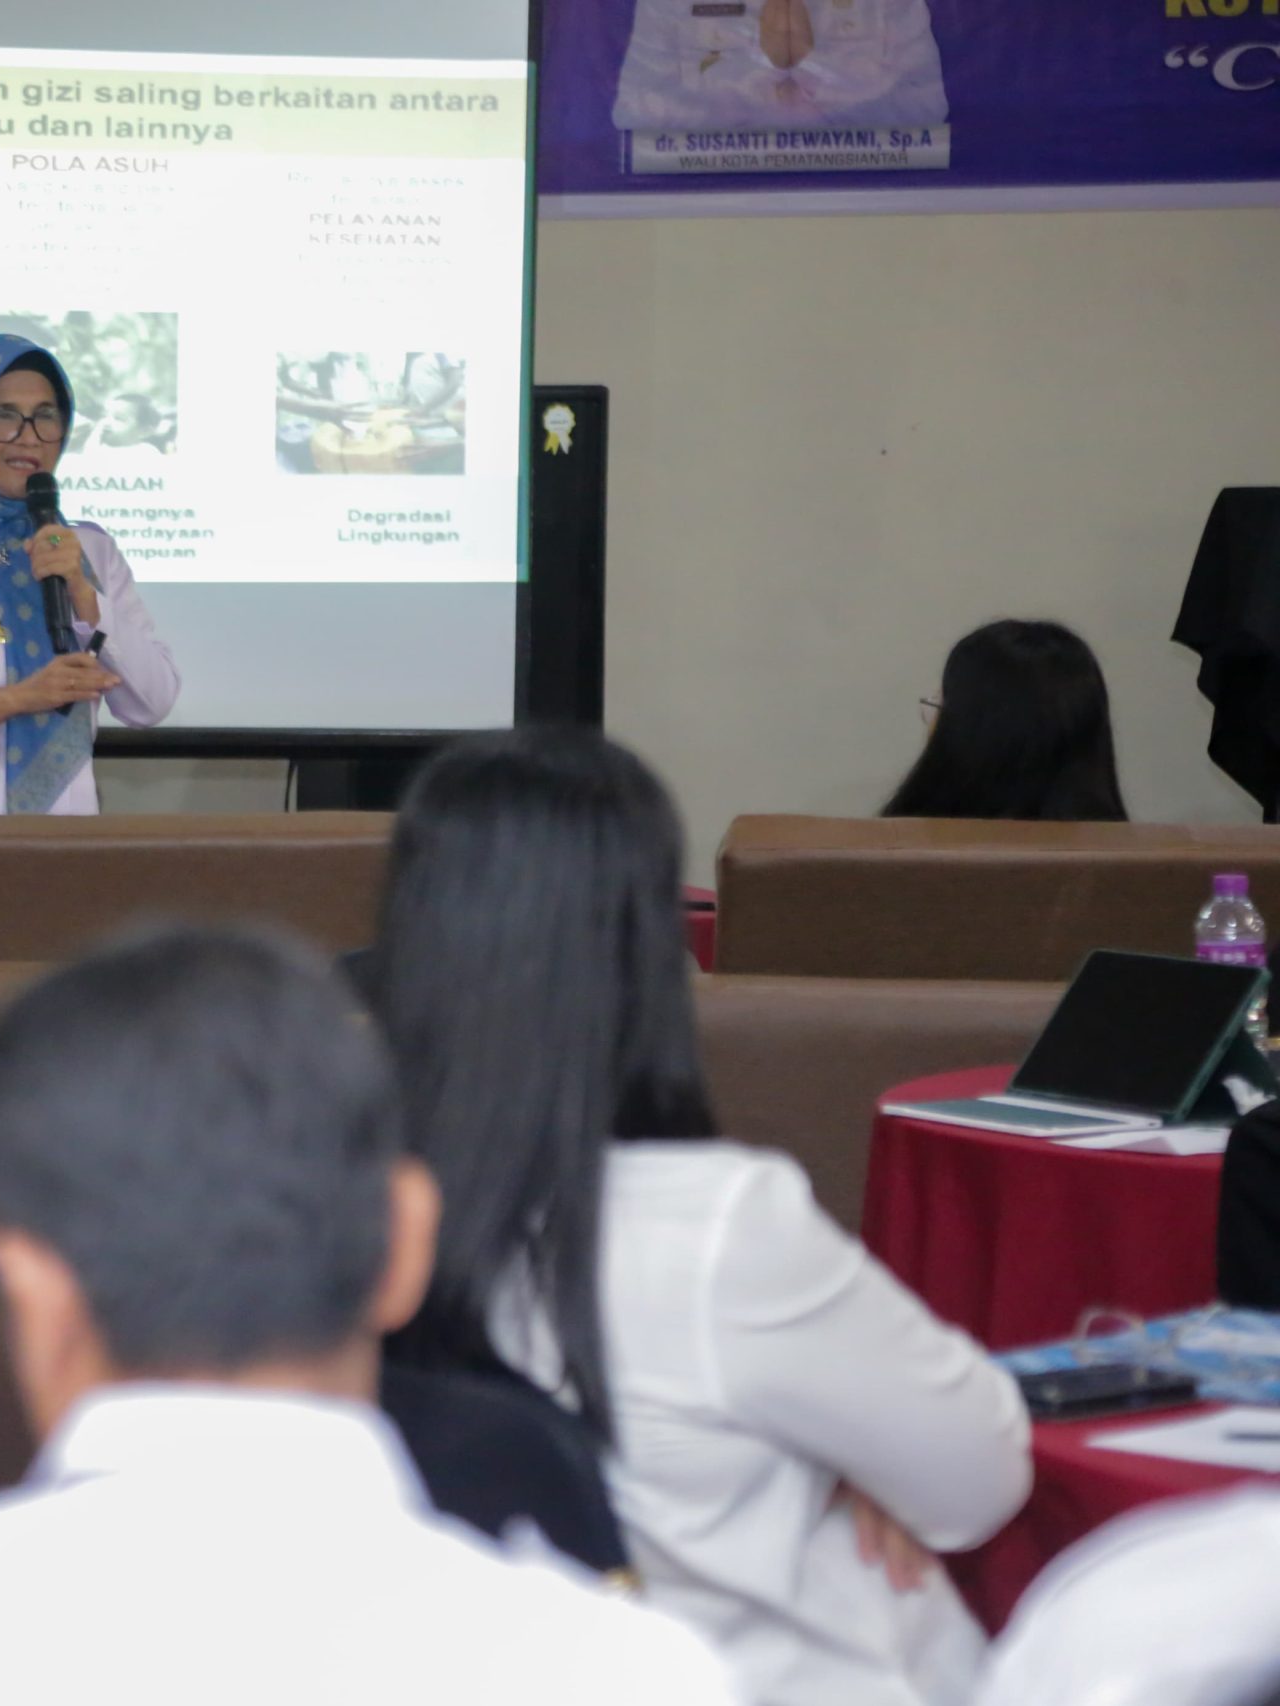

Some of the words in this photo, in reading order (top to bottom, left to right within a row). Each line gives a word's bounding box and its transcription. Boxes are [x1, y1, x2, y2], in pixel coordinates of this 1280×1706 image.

[21, 79, 82, 107] gizi
[94, 82, 202, 111] saling
[213, 85, 378, 110] berkaitan
[388, 90, 500, 112] antara
[27, 114, 93, 137] dan
[104, 117, 234, 145] lainnya
[655, 134, 678, 152] dr.
[686, 132, 769, 151] SUSANTI
[12, 154, 86, 172] POLA
[94, 155, 170, 174] ASUH
[58, 476, 163, 492] MASALAH
[81, 504, 195, 521] Kurangnya
[347, 509, 451, 526] Degradasi
[106, 526, 215, 542] berdayaan
[337, 529, 461, 545] Lingkungan
[123, 547, 196, 561] mpuan
